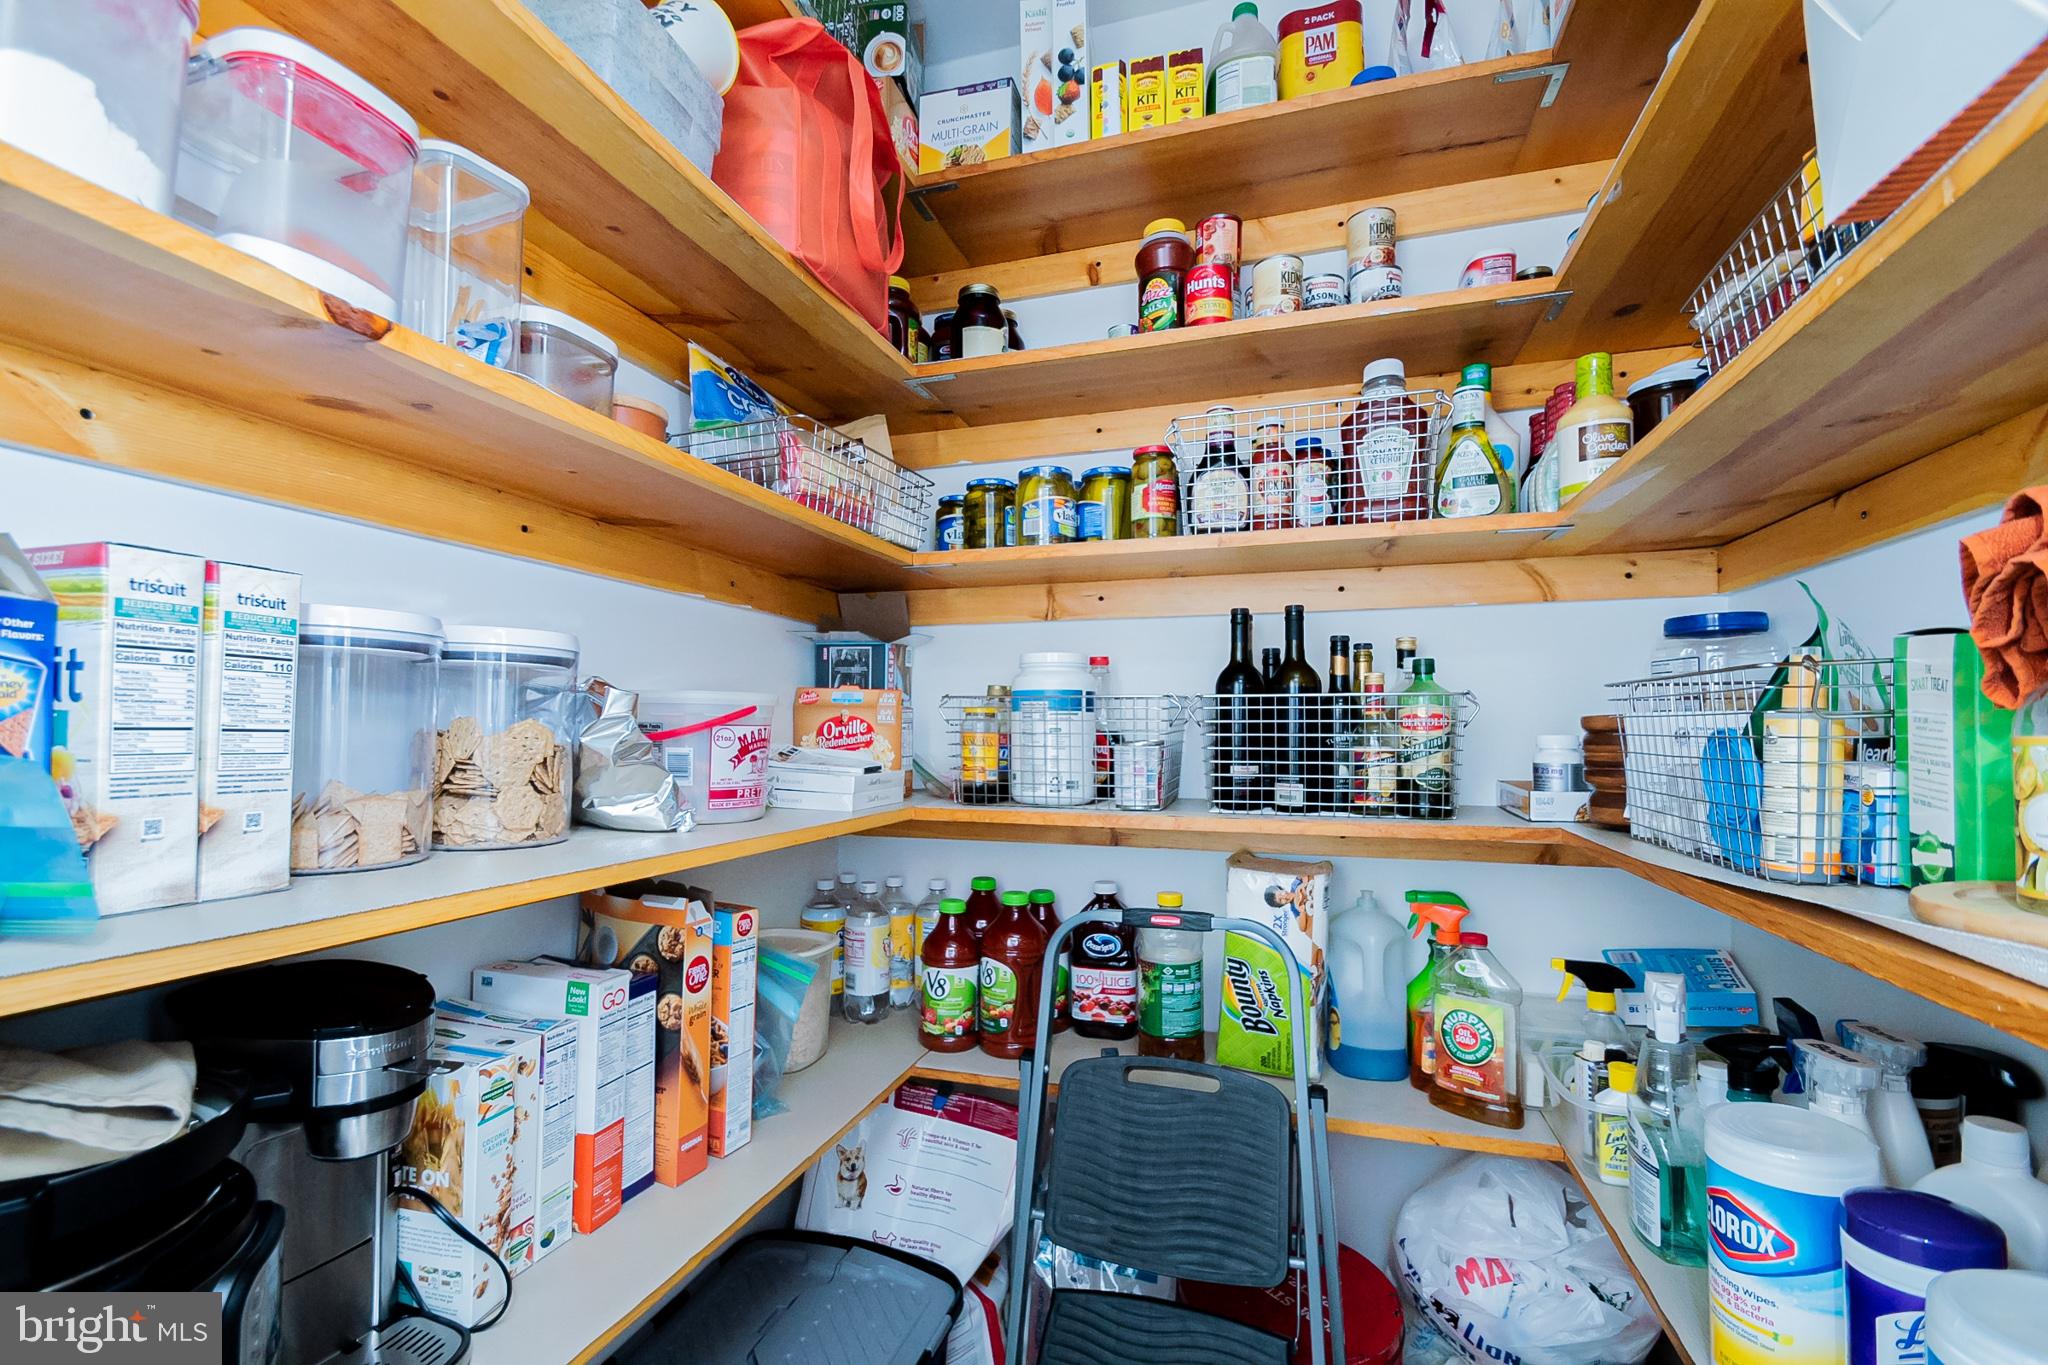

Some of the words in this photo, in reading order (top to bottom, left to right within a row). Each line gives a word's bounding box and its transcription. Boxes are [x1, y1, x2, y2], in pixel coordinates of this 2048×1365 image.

[1024, 8, 1048, 19] Kashi
[1304, 17, 1310, 25] 2
[1311, 11, 1335, 23] PACK
[1305, 31, 1335, 54] PAM
[1136, 93, 1158, 106] KIT
[1175, 86, 1197, 98] KIT
[937, 110, 991, 125] CRUNCHMASTER
[931, 121, 999, 142] MULTI-GRAIN
[1143, 302, 1168, 316] SALSA
[1582, 432, 1615, 444] Olive
[1587, 441, 1629, 454] Garden
[129, 577, 187, 597] triscuit
[237, 592, 287, 611] triscuit
[3, 617, 34, 629] Other
[231, 613, 274, 624] REDUCED
[276, 618, 292, 626] FAT
[1, 629, 45, 641] Flavors:
[116, 621, 165, 633] Nutrition
[168, 626, 196, 636] Facts
[225, 632, 267, 643] Nutrition
[270, 637, 294, 646] Facts
[114, 653, 160, 664] Calories
[173, 654, 196, 665] 110
[224, 661, 264, 671] Calories
[273, 662, 293, 672] 110
[1930, 678, 1949, 692] TREAT
[823, 720, 868, 739] Orville
[817, 732, 875, 750] Redenbacher's
[1541, 767, 1550, 775] 25
[1551, 768, 1563, 776] mg
[1273, 915, 1283, 931] 2X
[982, 960, 993, 985] V8
[1705, 956, 1739, 992] SHEETS
[569, 986, 586, 995] New
[927, 970, 947, 997] V8
[568, 994, 587, 1004] Look!
[602, 988, 626, 1010] GO
[1227, 957, 1278, 1036] Bounty
[1260, 969, 1287, 1019] Napkins
[688, 1010, 707, 1027] grain
[1443, 1011, 1492, 1042] MURPHY
[1457, 1028, 1472, 1038] OIL
[1456, 1034, 1476, 1046] SOAP
[482, 1128, 510, 1149] COCONUT
[483, 1137, 509, 1154] CASHEW
[421, 1169, 449, 1187] ON
[1734, 1301, 1775, 1327] Bacteria
[1751, 1304, 1761, 1313] of
